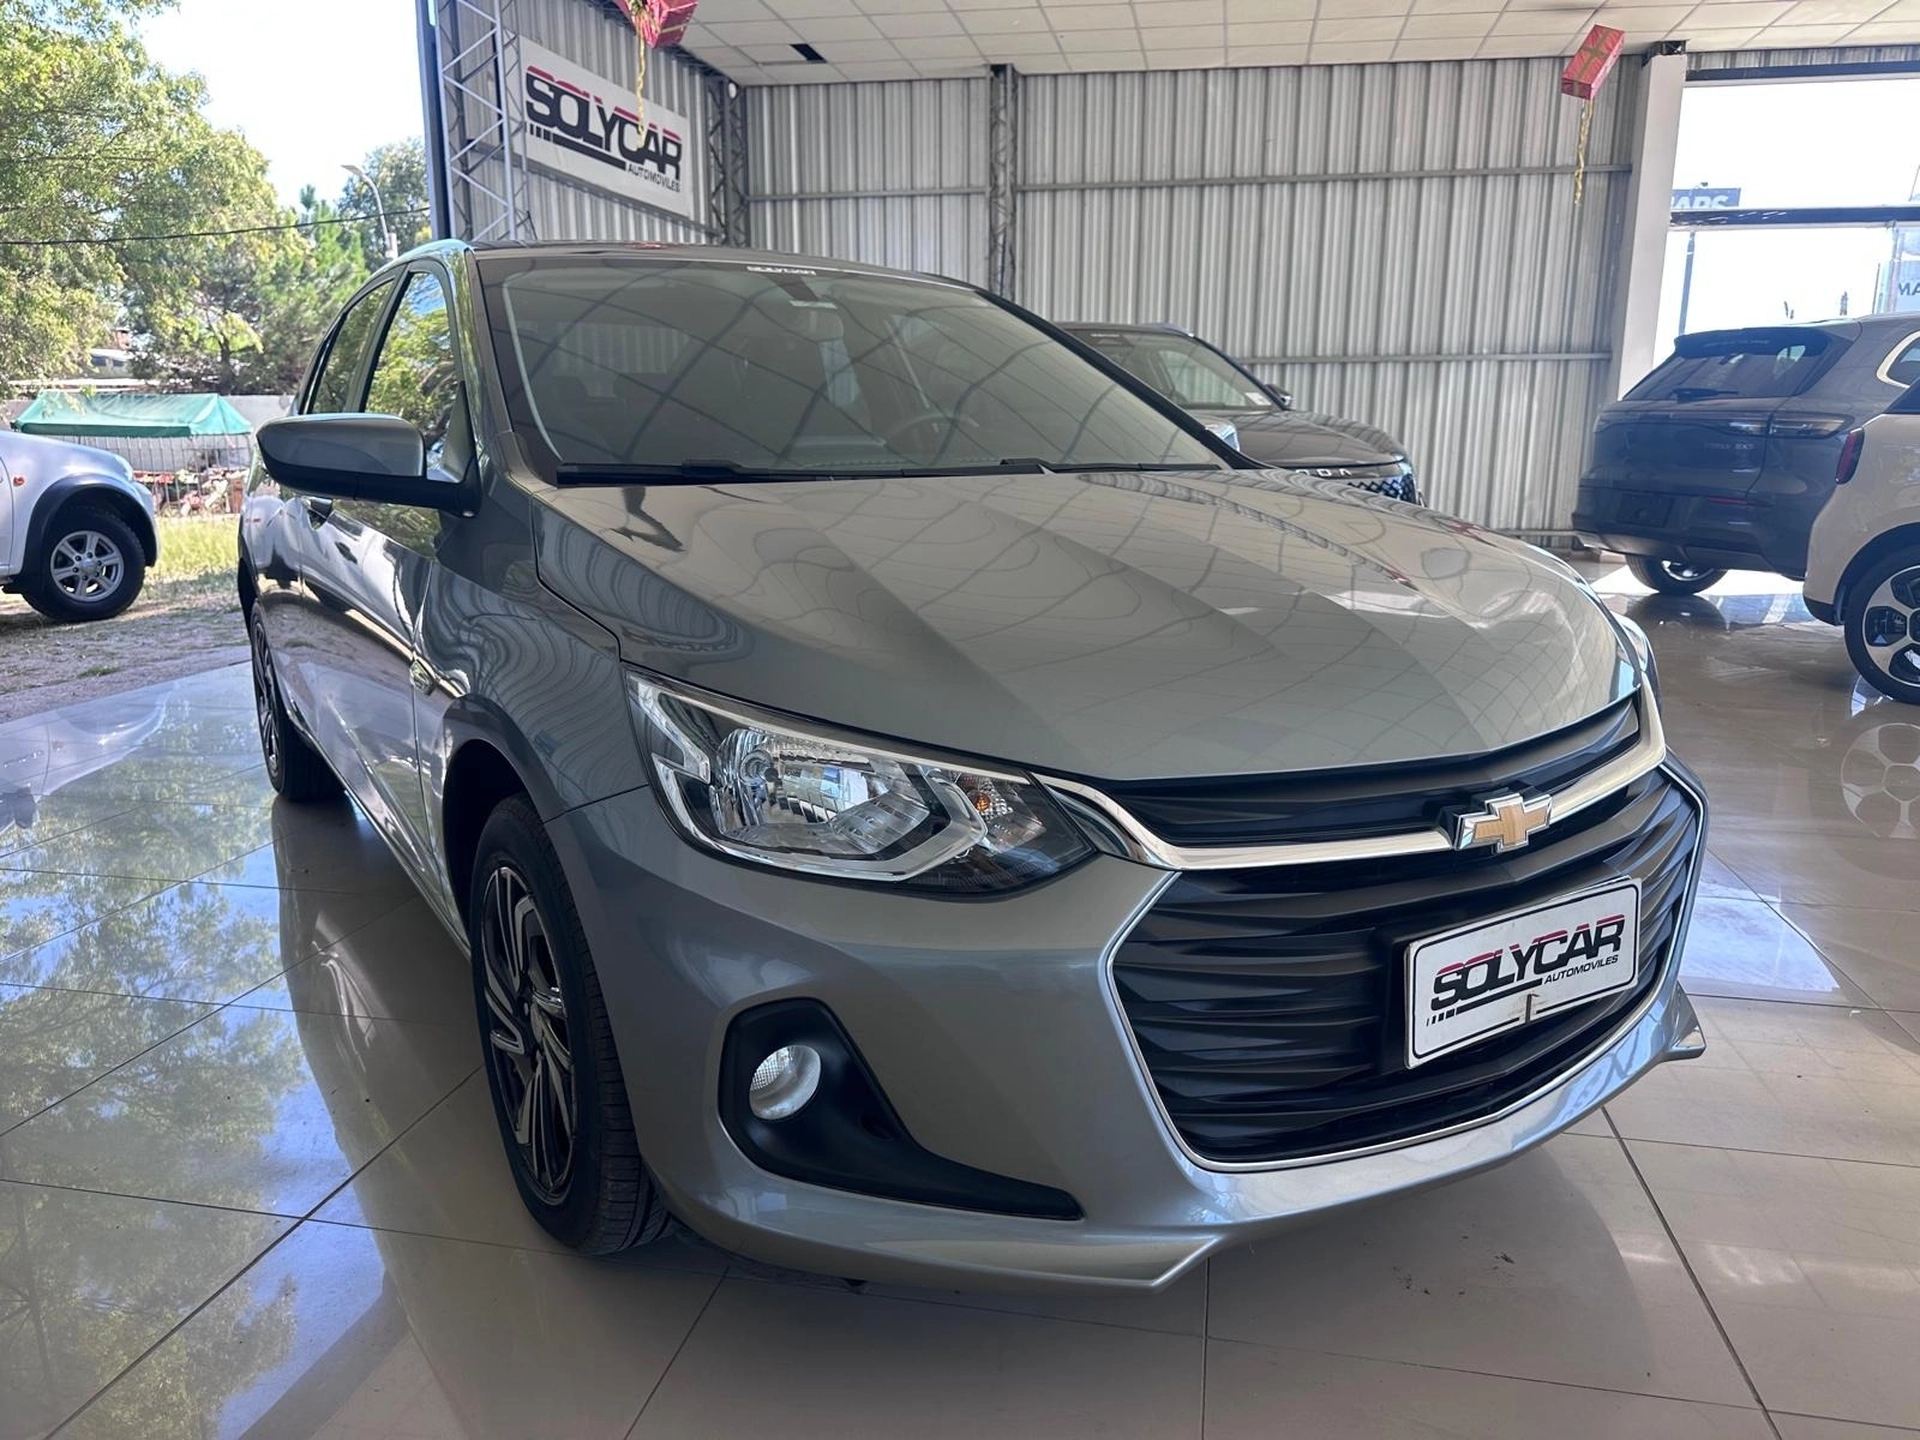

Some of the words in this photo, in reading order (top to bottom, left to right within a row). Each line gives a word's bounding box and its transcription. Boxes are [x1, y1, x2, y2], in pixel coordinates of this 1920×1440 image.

[526, 65, 682, 180] SOLYCAR
[628, 163, 681, 193] AUTOMOVILES
[1430, 913, 1625, 1012] SOLYCAR
[1544, 954, 1619, 985] AUTOMOVILES
